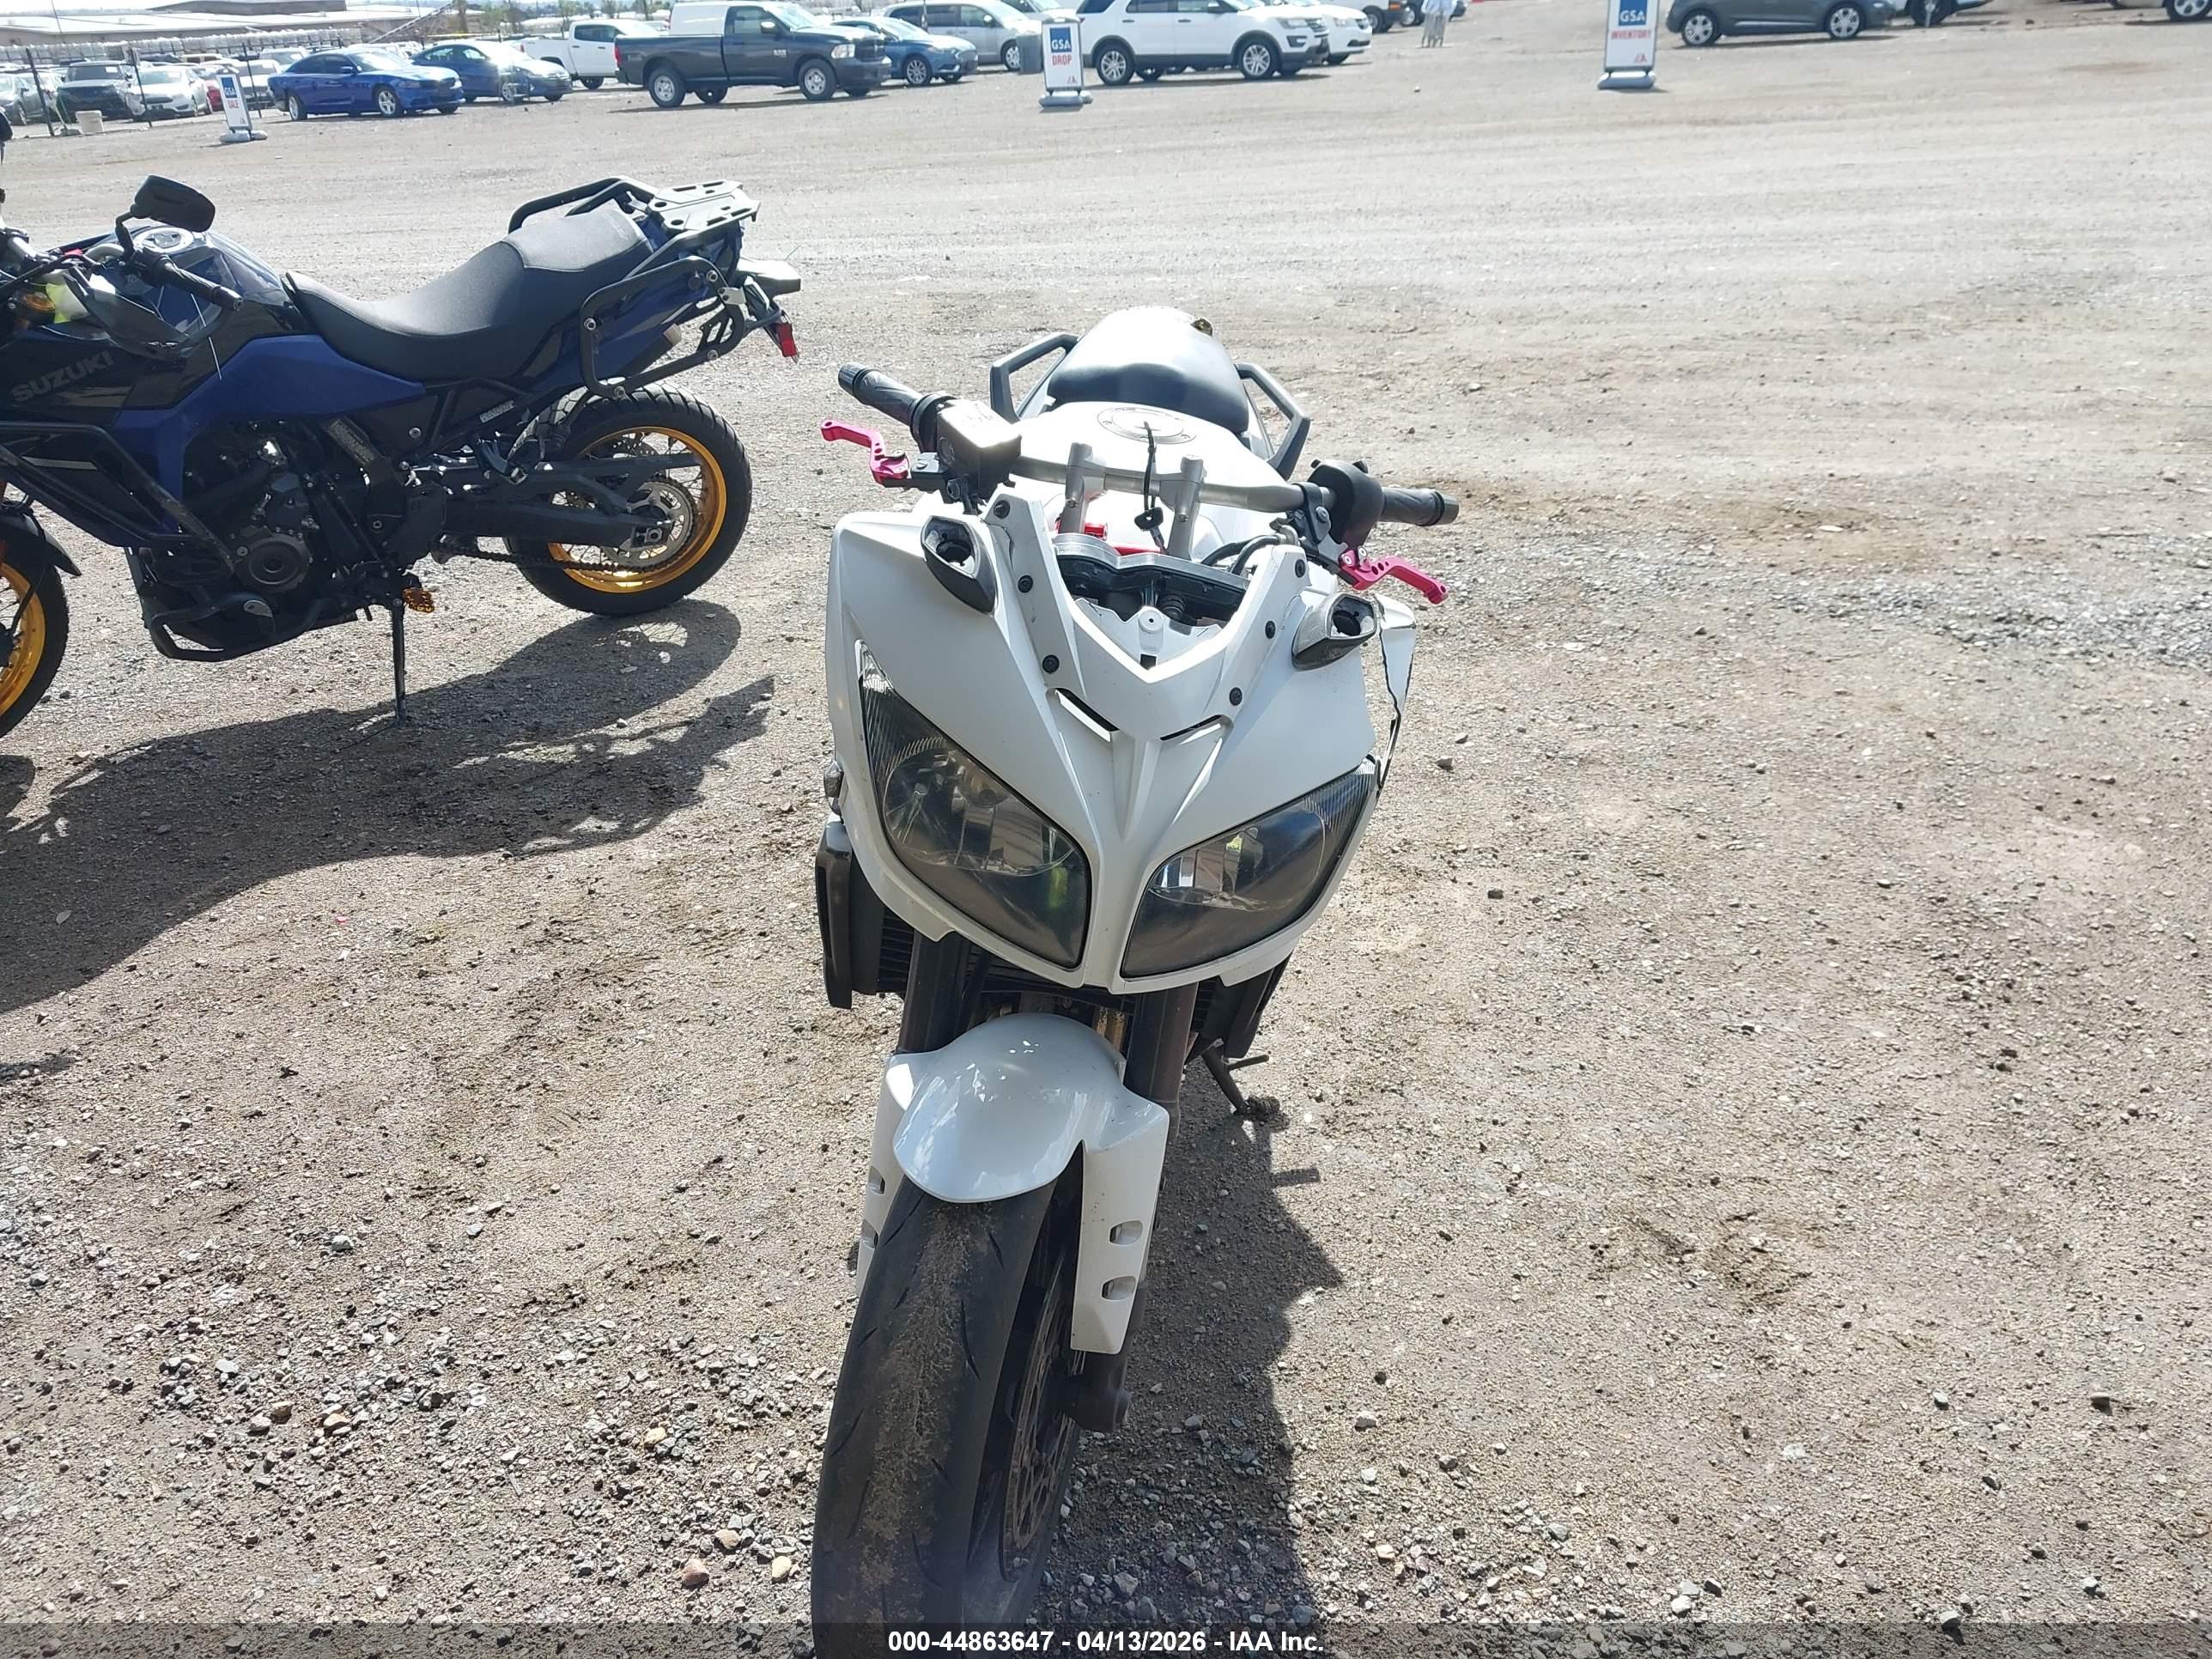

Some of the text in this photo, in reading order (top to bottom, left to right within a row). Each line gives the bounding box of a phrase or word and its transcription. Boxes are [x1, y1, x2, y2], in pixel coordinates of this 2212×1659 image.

[1620, 9, 1646, 22] GSA
[1051, 39, 1072, 50] GSA
[1052, 54, 1073, 66] DROP
[12, 350, 115, 403] SUZUKI
